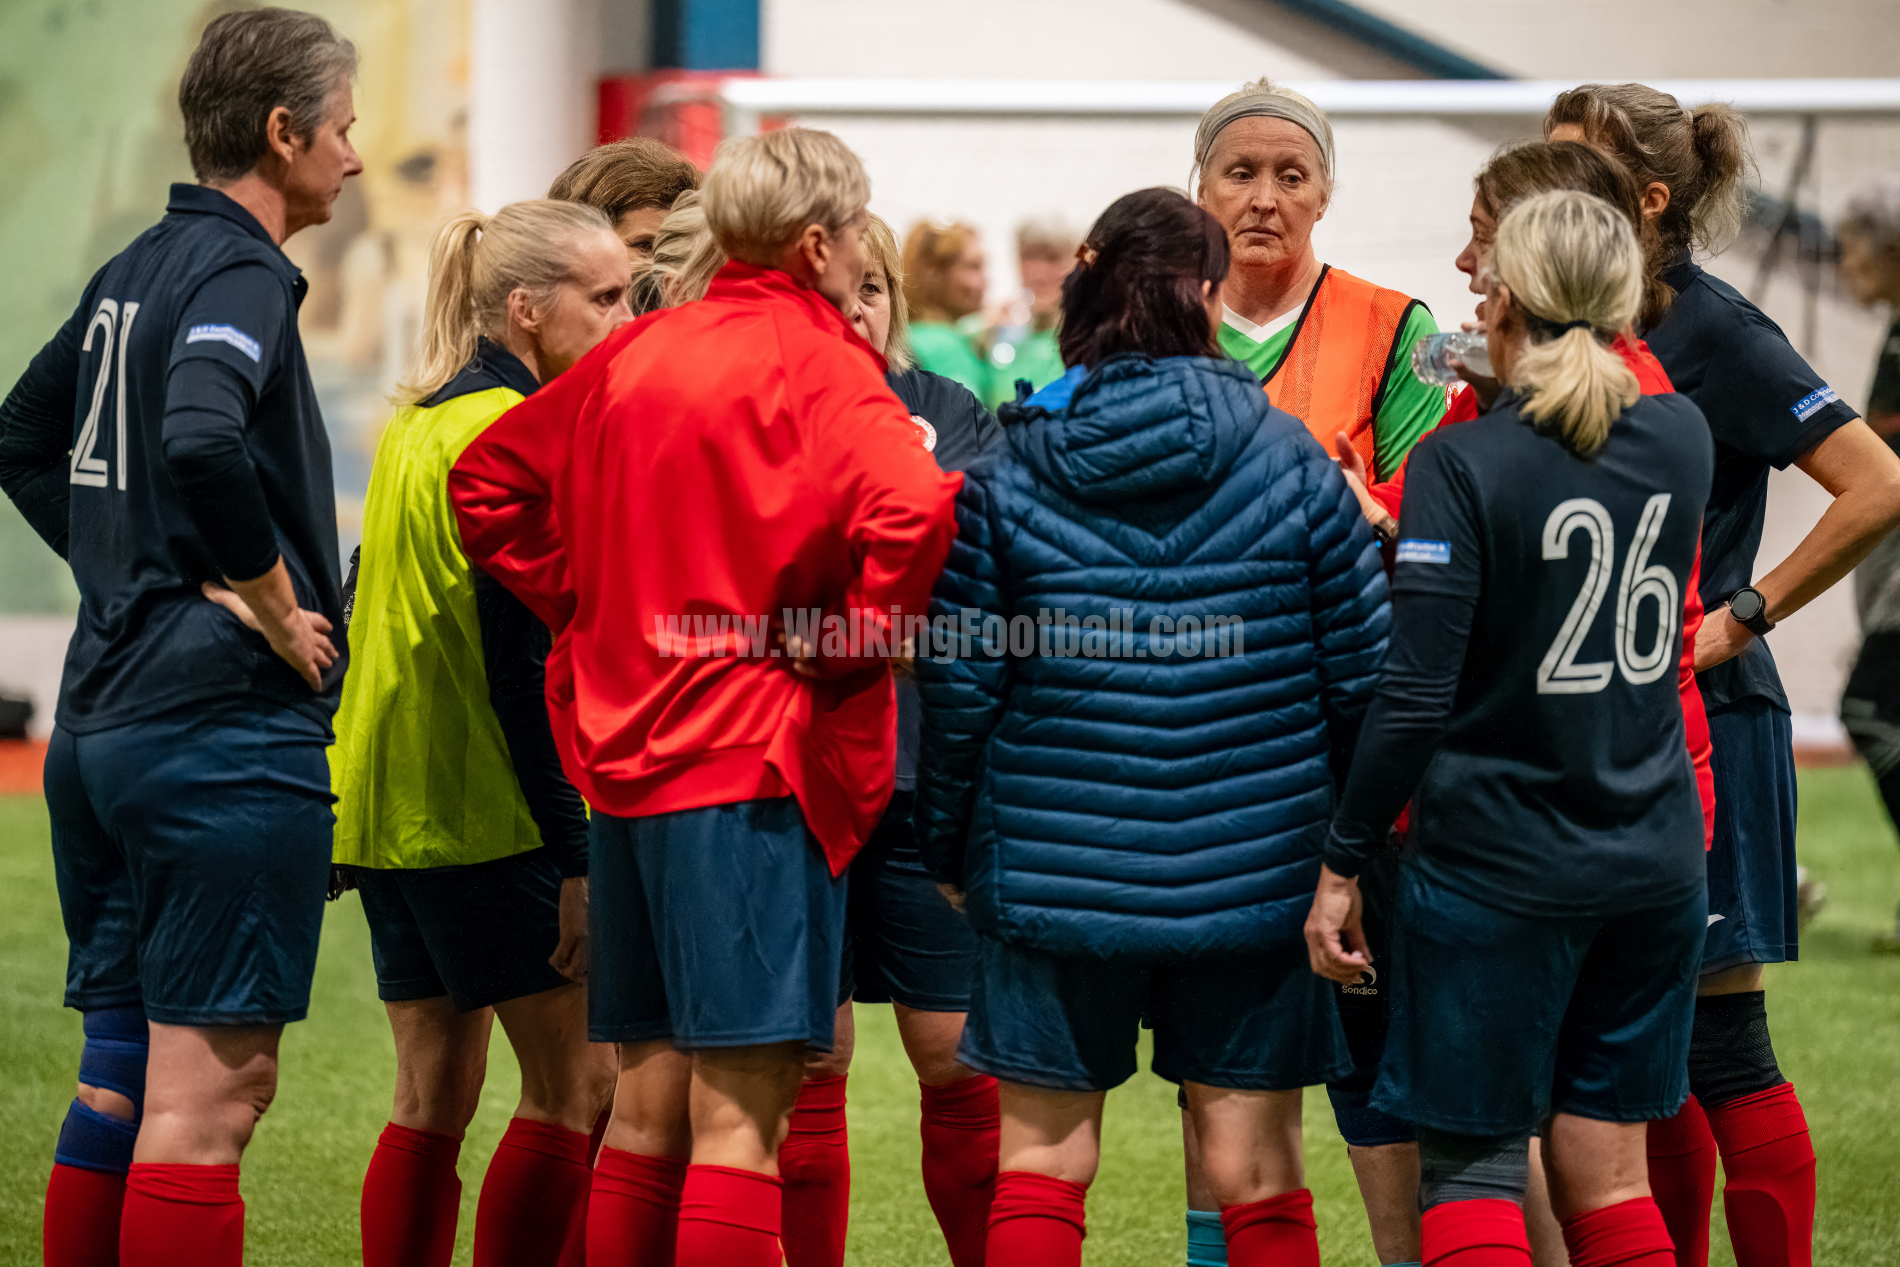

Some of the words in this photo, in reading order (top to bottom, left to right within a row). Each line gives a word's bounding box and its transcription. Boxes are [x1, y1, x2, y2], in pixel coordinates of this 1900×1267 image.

[70, 298, 140, 491] 21
[1537, 493, 1680, 694] 26
[1341, 984, 1378, 996] Sondico
